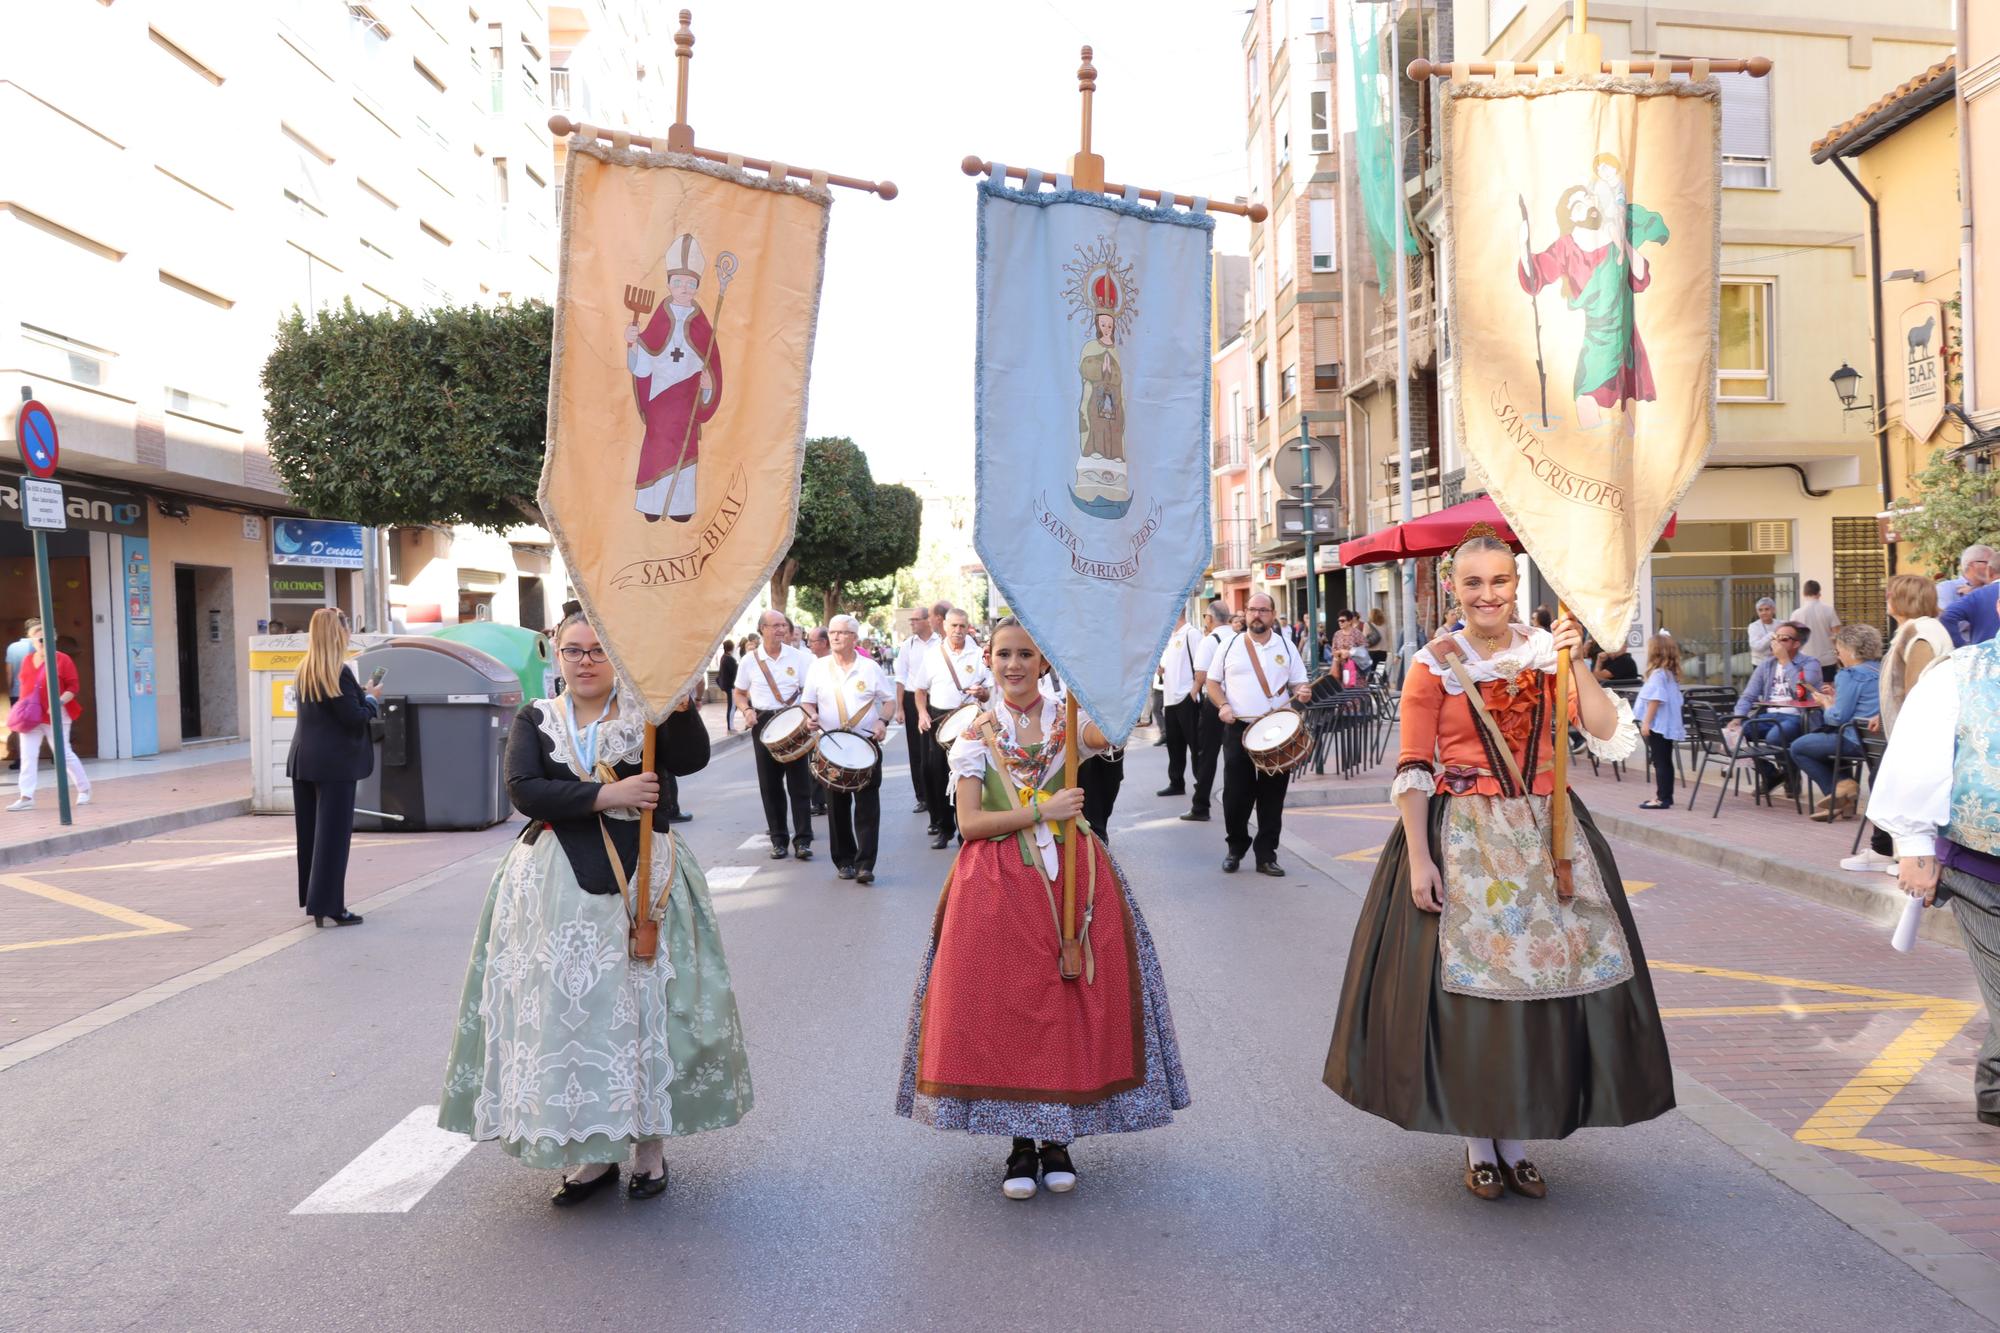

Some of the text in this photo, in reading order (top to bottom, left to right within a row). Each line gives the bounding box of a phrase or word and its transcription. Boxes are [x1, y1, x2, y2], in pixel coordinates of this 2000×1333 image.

[1908, 361, 1936, 384] BAR
[1495, 404, 1625, 513] SANT CRISTOFO
[641, 496, 741, 585] SANT BLAI
[1040, 512, 1077, 551] SANTA
[1075, 558, 1119, 578] MARIA
[1120, 562, 1136, 577] DEL
[272, 580, 324, 592] COLCHONES
